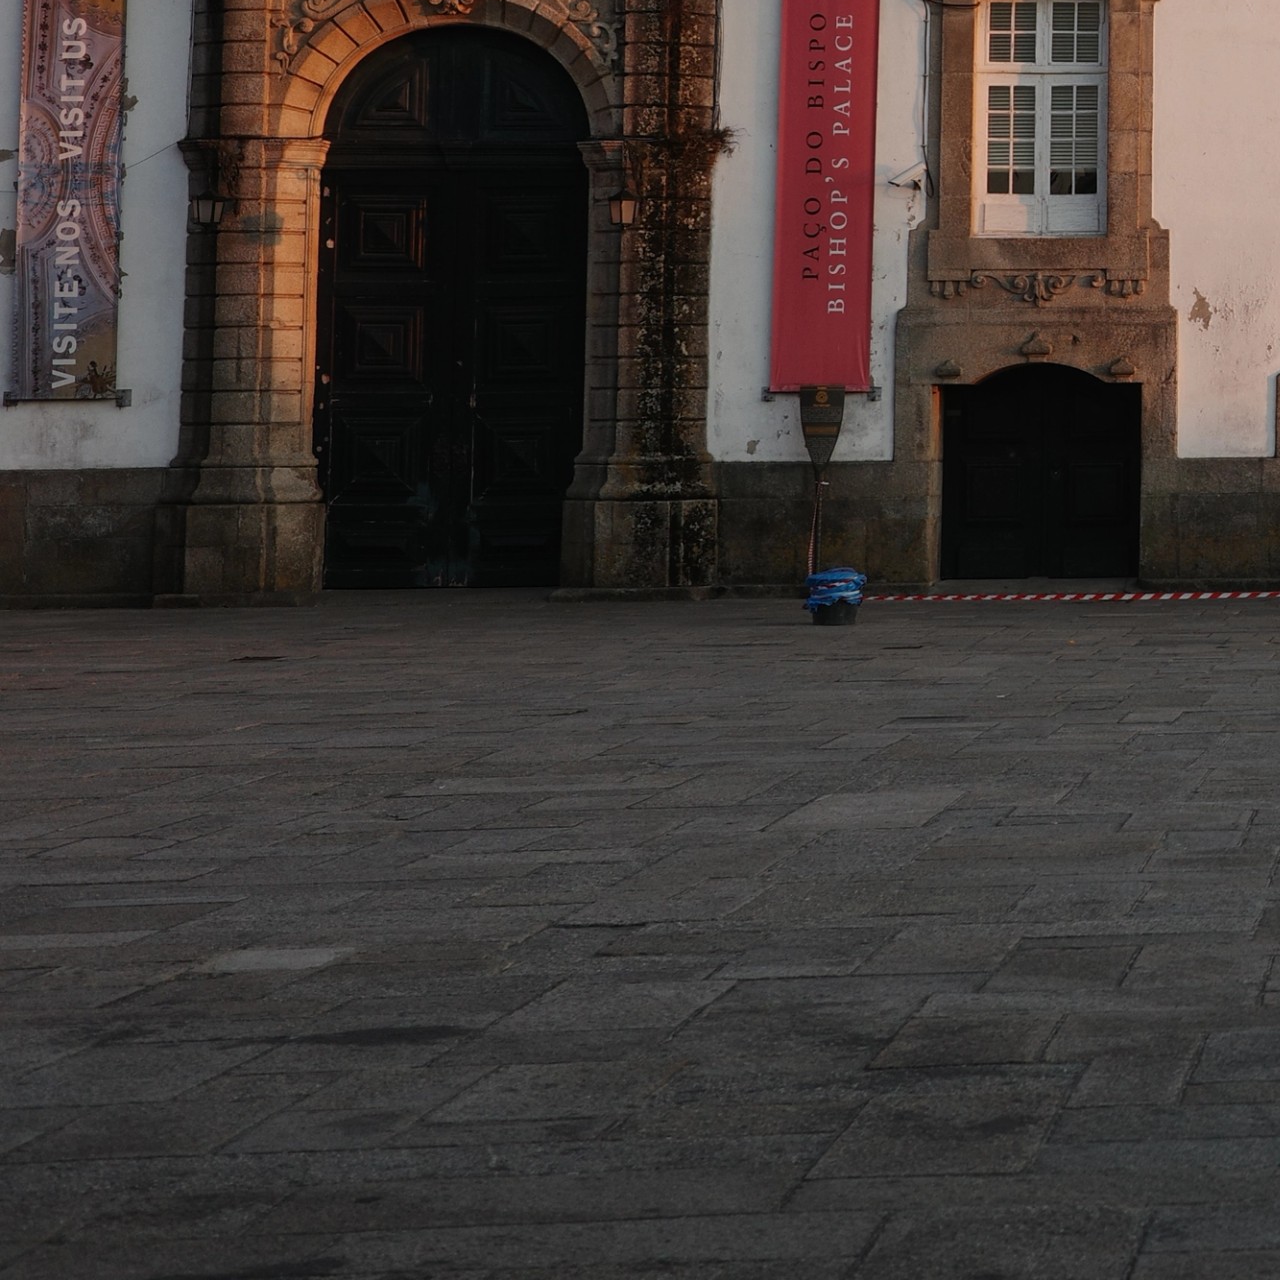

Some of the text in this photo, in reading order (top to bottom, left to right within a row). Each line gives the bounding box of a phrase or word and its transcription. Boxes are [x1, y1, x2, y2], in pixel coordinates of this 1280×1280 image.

[52, 17, 87, 390] VISITE-NOS VISIT US
[802, 13, 827, 281] PAÇO DO BISPO
[825, 14, 853, 314] BISHOP'S PALACE
